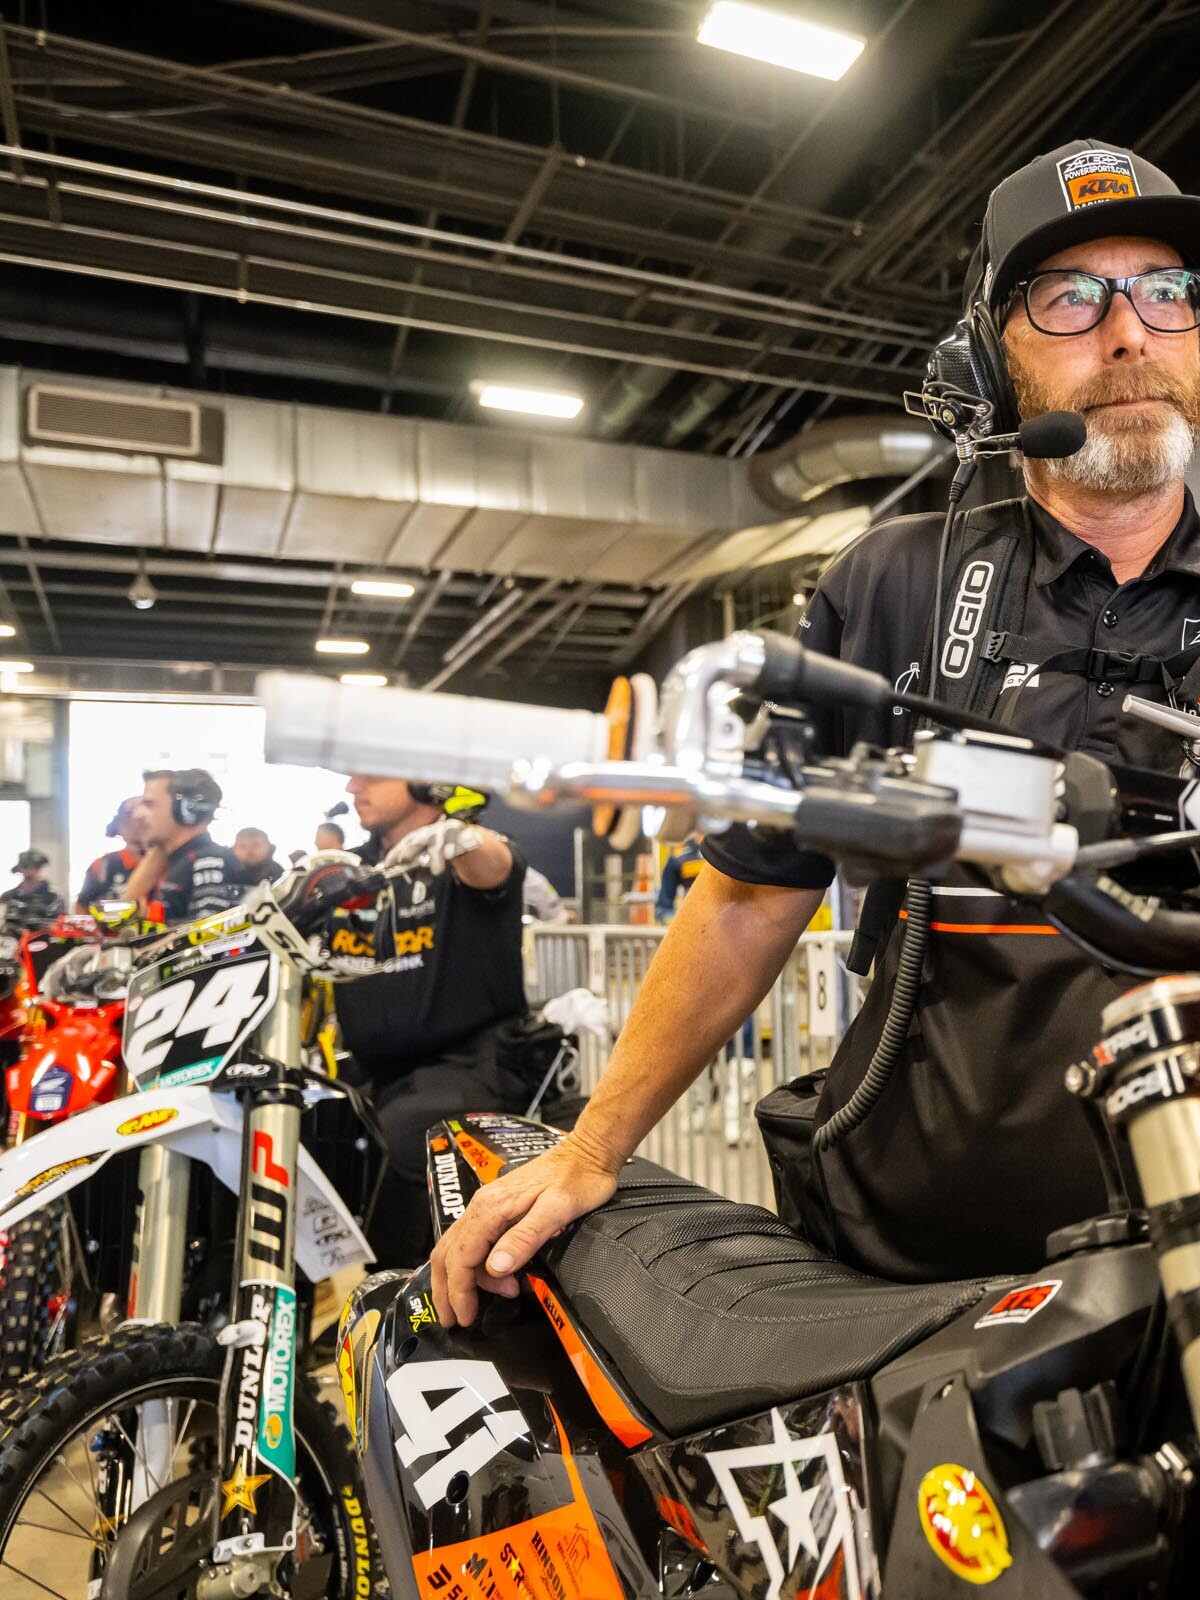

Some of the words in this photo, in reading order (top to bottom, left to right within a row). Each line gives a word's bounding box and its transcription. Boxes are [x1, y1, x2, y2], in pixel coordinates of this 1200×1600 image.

[1064, 165, 1131, 181] POWERSPORTS.COM
[1078, 178, 1129, 198] KTM
[940, 560, 994, 679] OGIO
[124, 959, 270, 1076] 24
[817, 970, 828, 1011] 8
[118, 1109, 178, 1135] FMF
[249, 1129, 290, 1272] WP
[434, 1152, 467, 1220] DUNLOP
[267, 1298, 297, 1413] MOTOREX
[408, 1293, 438, 1333] SMX
[234, 1294, 273, 1450] DUNLP
[386, 1359, 531, 1511] 41
[345, 1496, 371, 1600] DUNLO
[530, 1531, 567, 1600] HINSON
